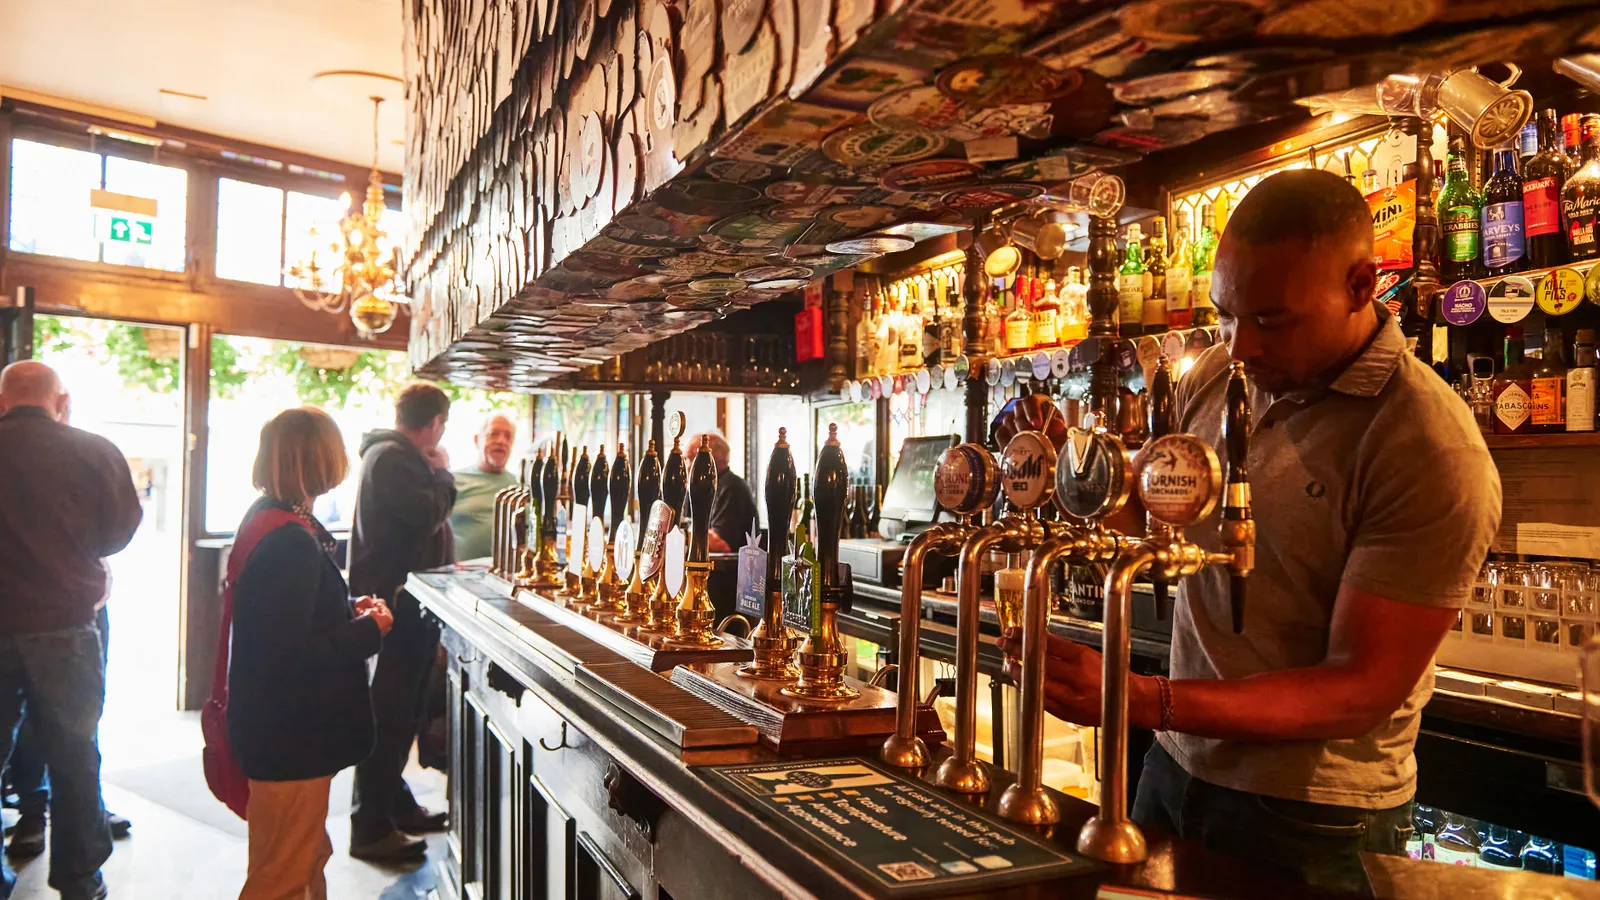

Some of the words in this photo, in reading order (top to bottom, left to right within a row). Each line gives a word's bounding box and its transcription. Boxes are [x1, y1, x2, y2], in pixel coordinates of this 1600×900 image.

[1483, 223, 1521, 237] ARVEYS
[1544, 280, 1565, 291] KILL
[1544, 289, 1567, 301] PILS
[1496, 402, 1534, 411] TABASCO
[1148, 474, 1197, 488] ORNISH
[751, 602, 760, 611] ALE
[808, 802, 851, 825] Aroma
[856, 796, 889, 815] Taste
[874, 787, 894, 796] are
[891, 794, 939, 819] regularly
[936, 817, 981, 838] tested
[784, 804, 858, 848] Appearance
[833, 798, 908, 842] Temperature
[908, 791, 934, 804] cask
[930, 803, 954, 815] ales
[952, 814, 967, 822] in
[965, 820, 990, 833] this
[984, 831, 1016, 846] pub
